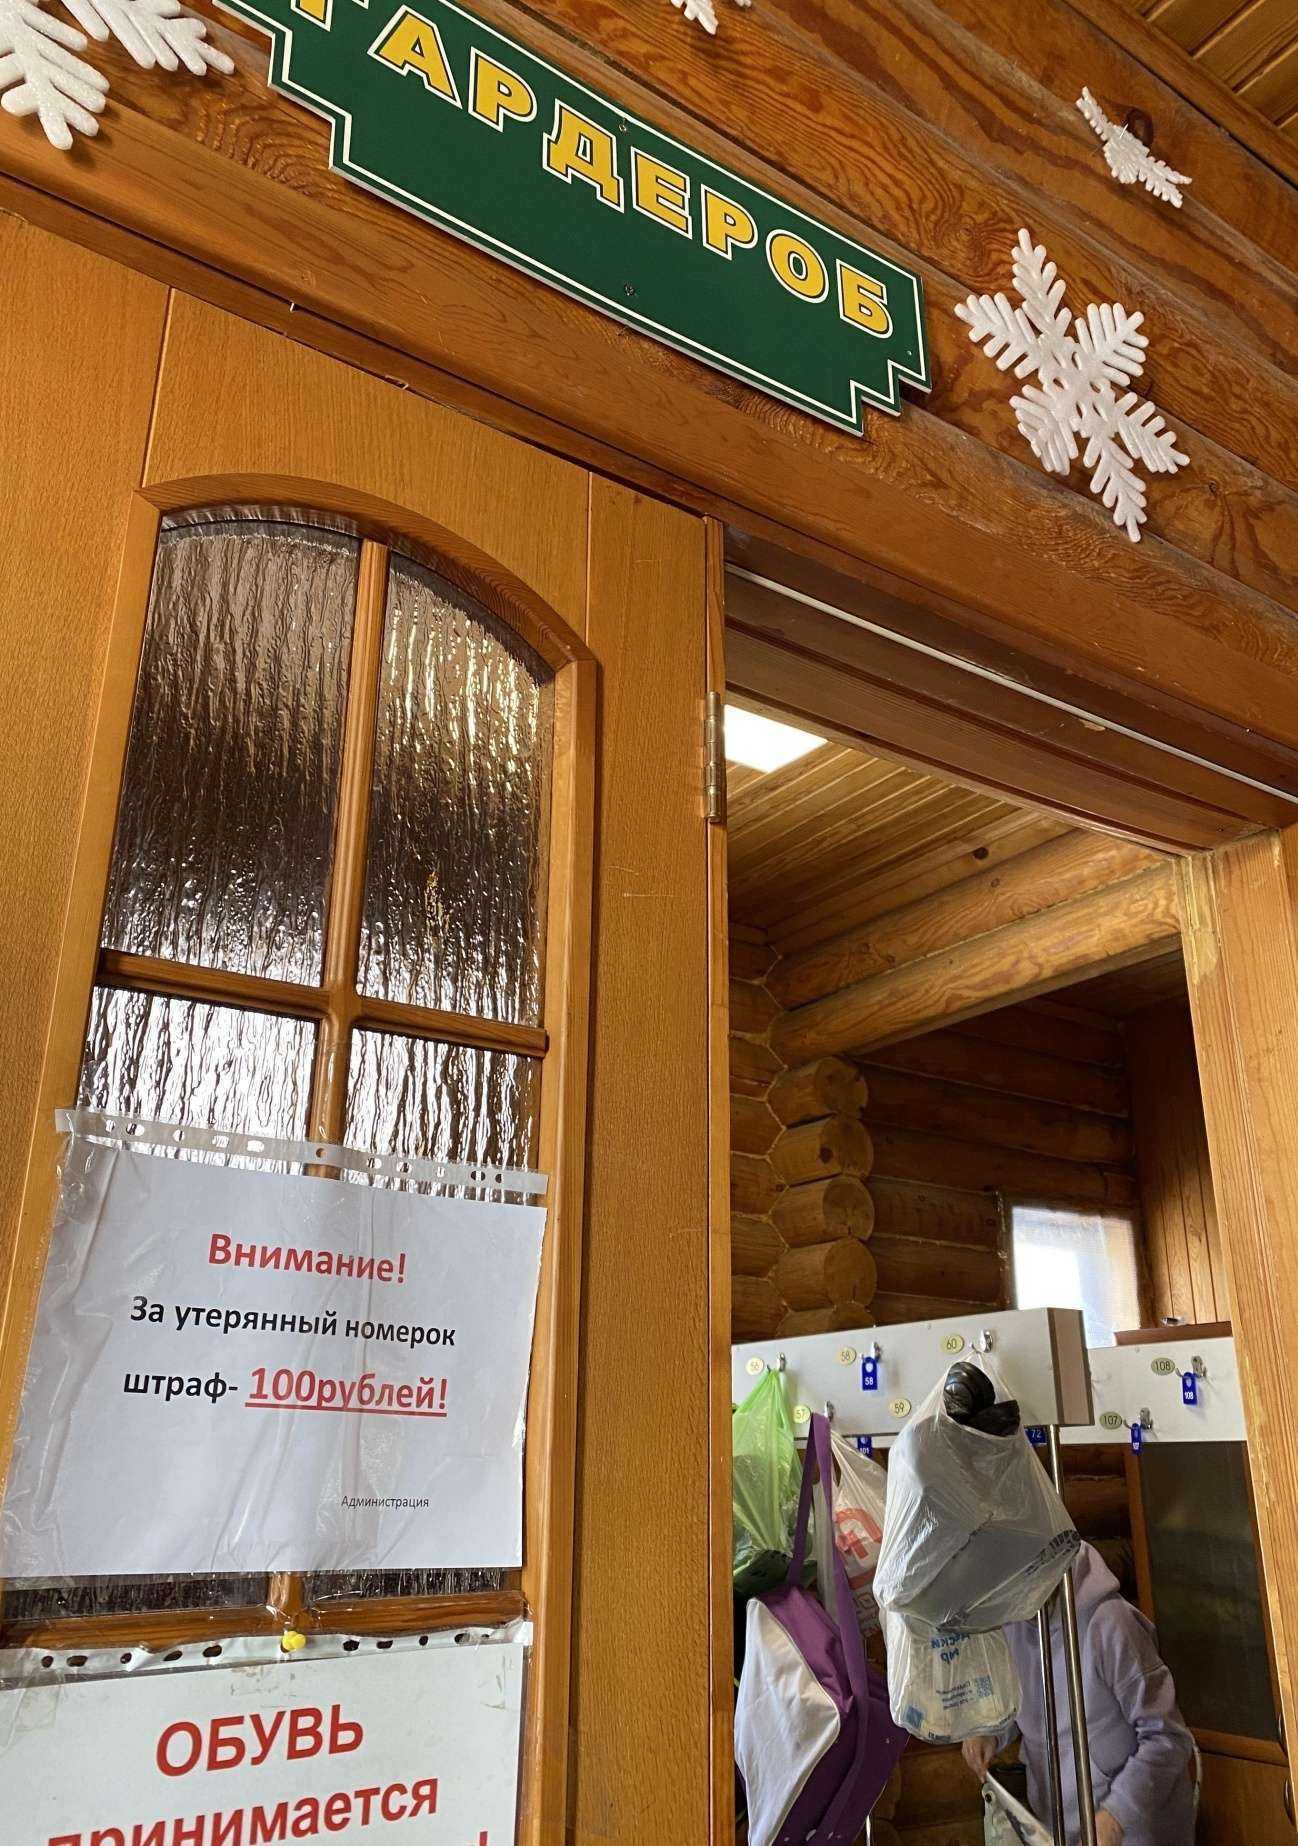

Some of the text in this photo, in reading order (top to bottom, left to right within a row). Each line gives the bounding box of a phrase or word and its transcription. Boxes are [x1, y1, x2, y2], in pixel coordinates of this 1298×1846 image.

[208, 1233, 407, 1284] Внимание!
[130, 1296, 456, 1349] За утерянный номерок
[946, 1338, 958, 1350] 60
[1154, 1360, 1173, 1372] 108
[865, 1376, 874, 1386] 58
[123, 1367, 448, 1413] штраф- 100рублей!
[796, 1407, 807, 1420] 57
[893, 1401, 905, 1414] 59
[1102, 1415, 1119, 1426] 107
[341, 1495, 430, 1511] Администрация
[156, 1704, 364, 1777] ОБУВЬ
